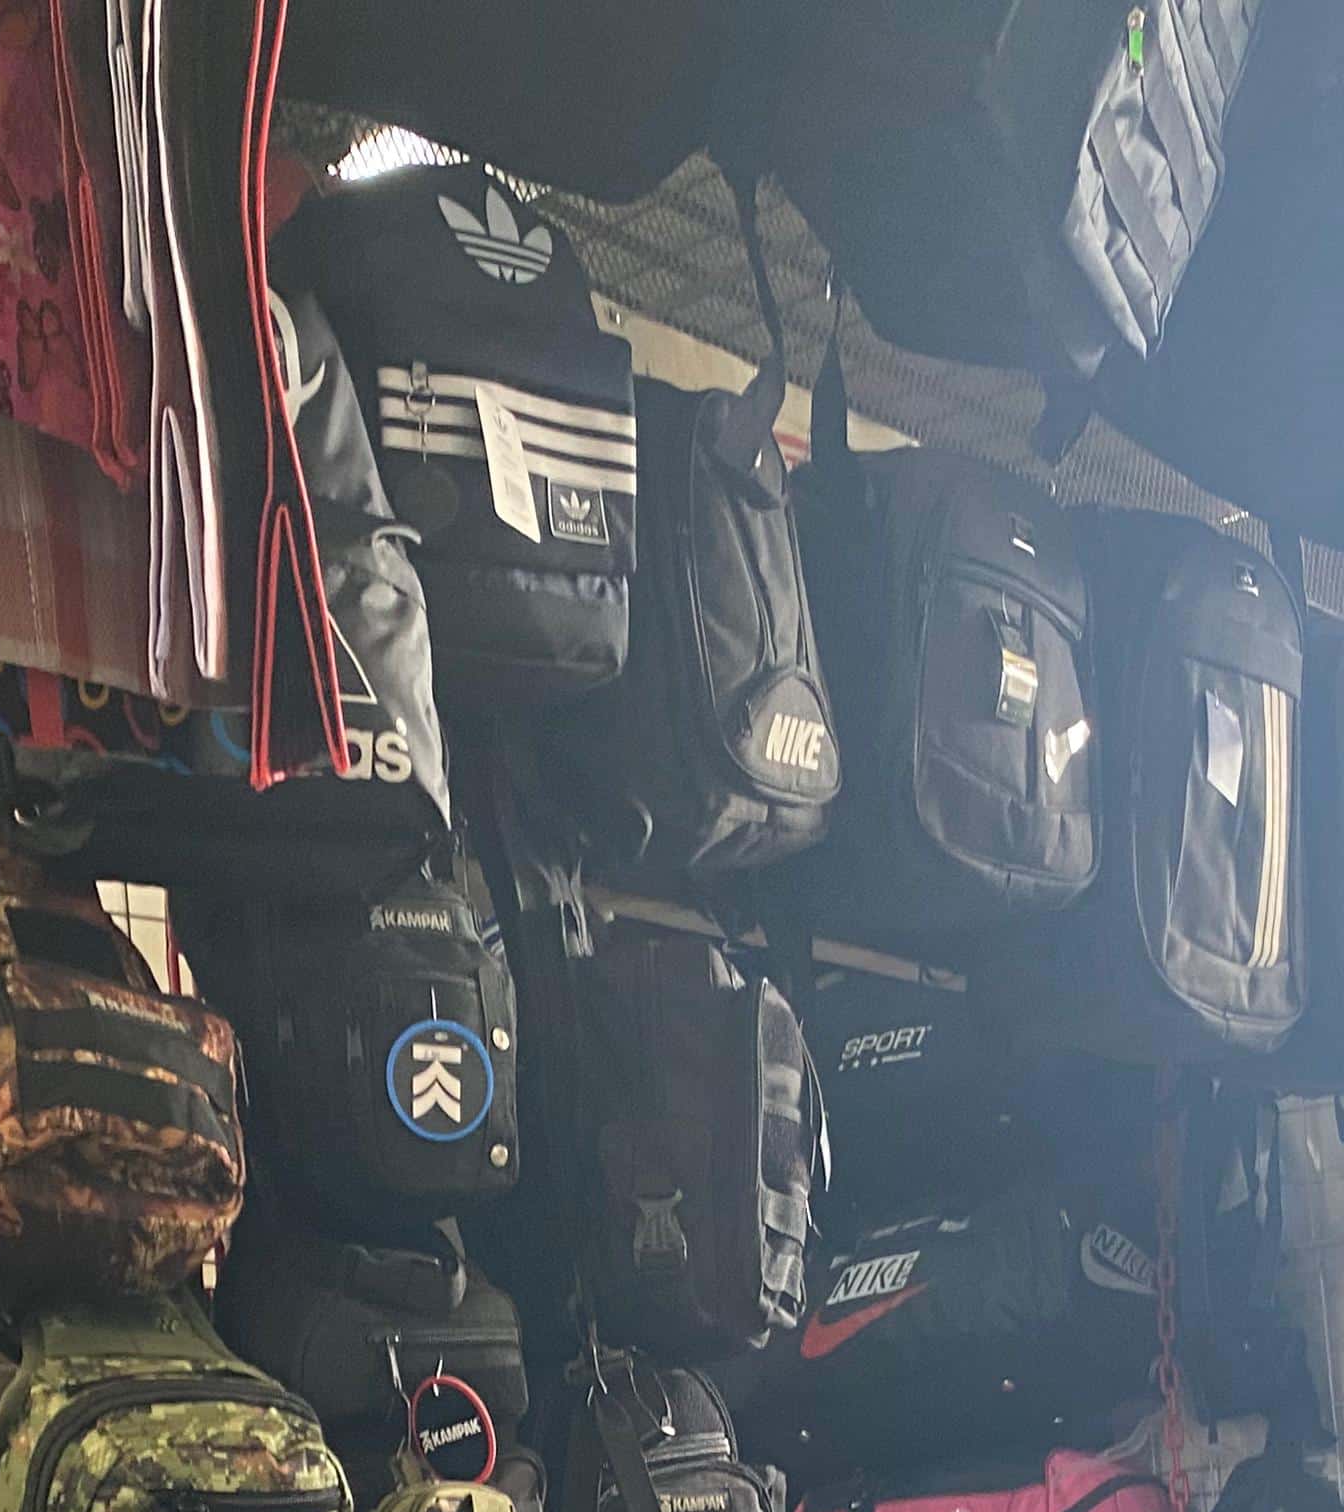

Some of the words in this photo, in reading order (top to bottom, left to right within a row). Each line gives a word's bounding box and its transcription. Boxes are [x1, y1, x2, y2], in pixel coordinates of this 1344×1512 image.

[558, 519, 599, 537] adidas
[766, 712, 825, 771] NIKE
[384, 909, 453, 932] KAMPAK
[841, 1026, 928, 1060] SPORT
[826, 1250, 920, 1305] NIKE
[431, 1416, 482, 1446] KAMPAK
[672, 1493, 726, 1512] KAMPAK
